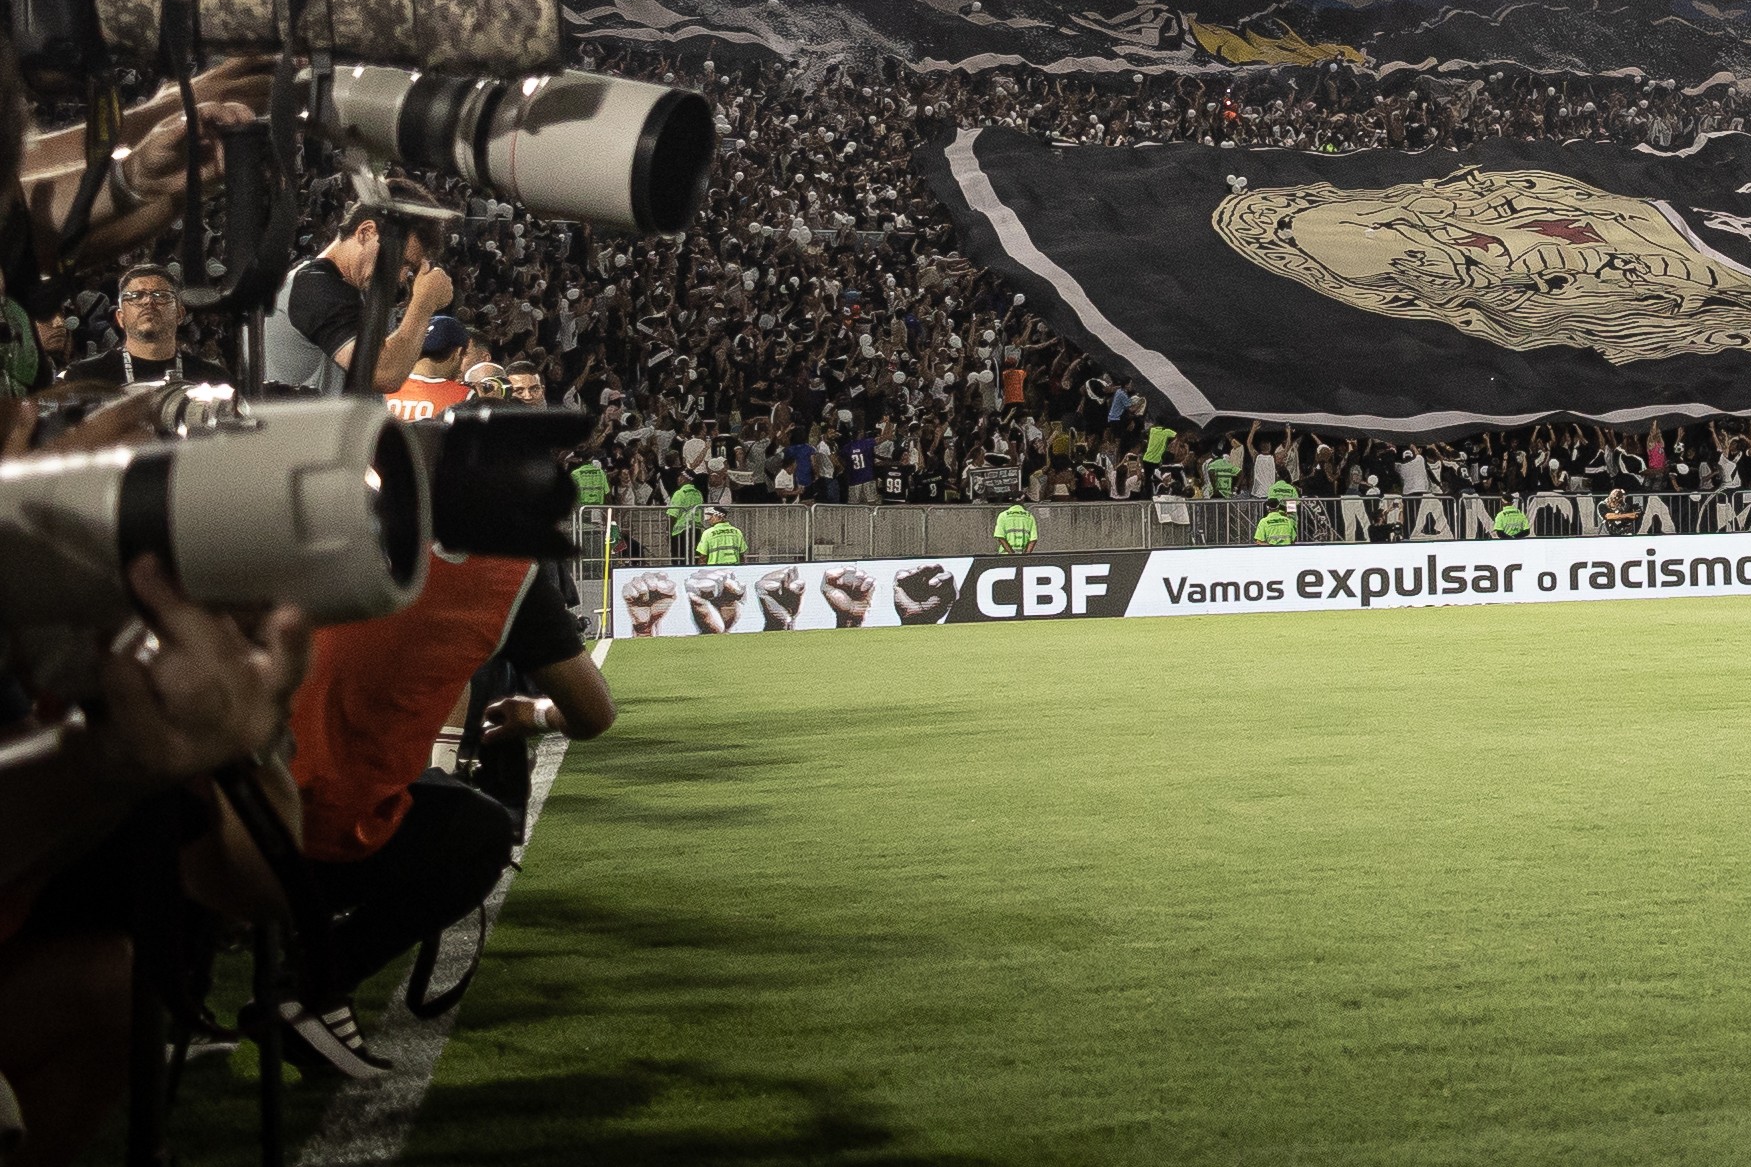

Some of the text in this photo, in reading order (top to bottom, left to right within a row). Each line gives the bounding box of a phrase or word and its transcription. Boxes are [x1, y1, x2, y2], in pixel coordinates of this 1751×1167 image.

[386, 398, 435, 421] OTO
[851, 453, 865, 470] 31
[886, 477, 902, 493] 99
[977, 564, 1110, 617] CBF
[1163, 577, 1284, 604] Vamos
[1297, 555, 1522, 607] expulsar
[1538, 572, 1557, 591] o
